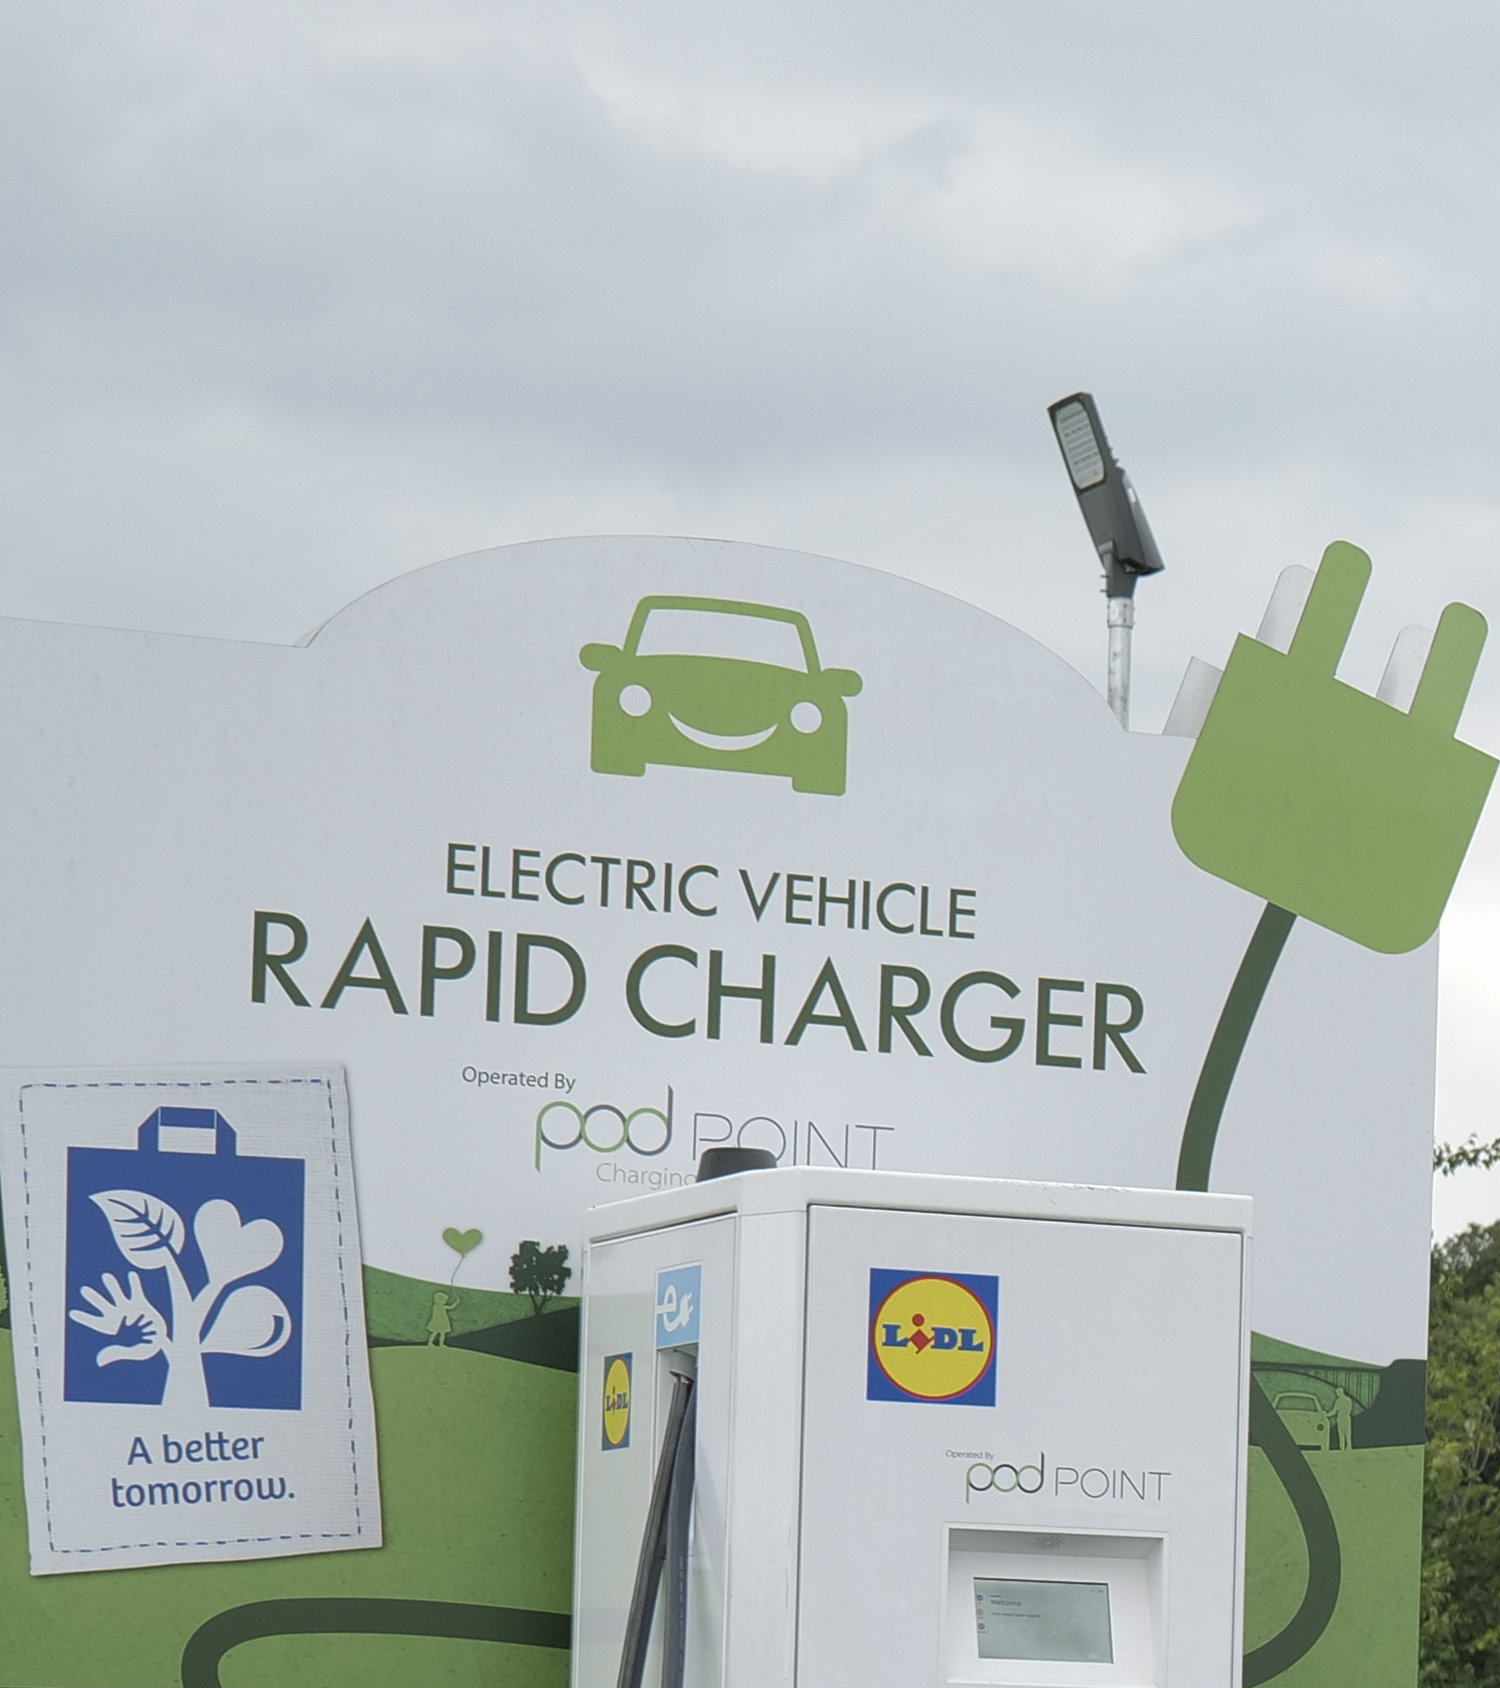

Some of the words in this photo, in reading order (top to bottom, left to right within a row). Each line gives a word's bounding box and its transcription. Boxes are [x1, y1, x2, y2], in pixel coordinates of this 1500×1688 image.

[445, 842, 719, 918] ELECTRIC
[738, 867, 977, 940] VEHICLE
[249, 909, 589, 1027] RAPID
[625, 942, 1149, 1077] CHARGER
[462, 1065, 548, 1090] Operated
[554, 1072, 576, 1093] By
[534, 1083, 673, 1174] pod
[126, 1437, 153, 1466] A
[163, 1430, 265, 1463] better
[946, 1449, 983, 1460] Operated
[985, 1452, 995, 1461] By
[111, 1475, 295, 1508] tomorrow.
[965, 1451, 1045, 1505] pod
[1055, 1466, 1172, 1501] POINT
